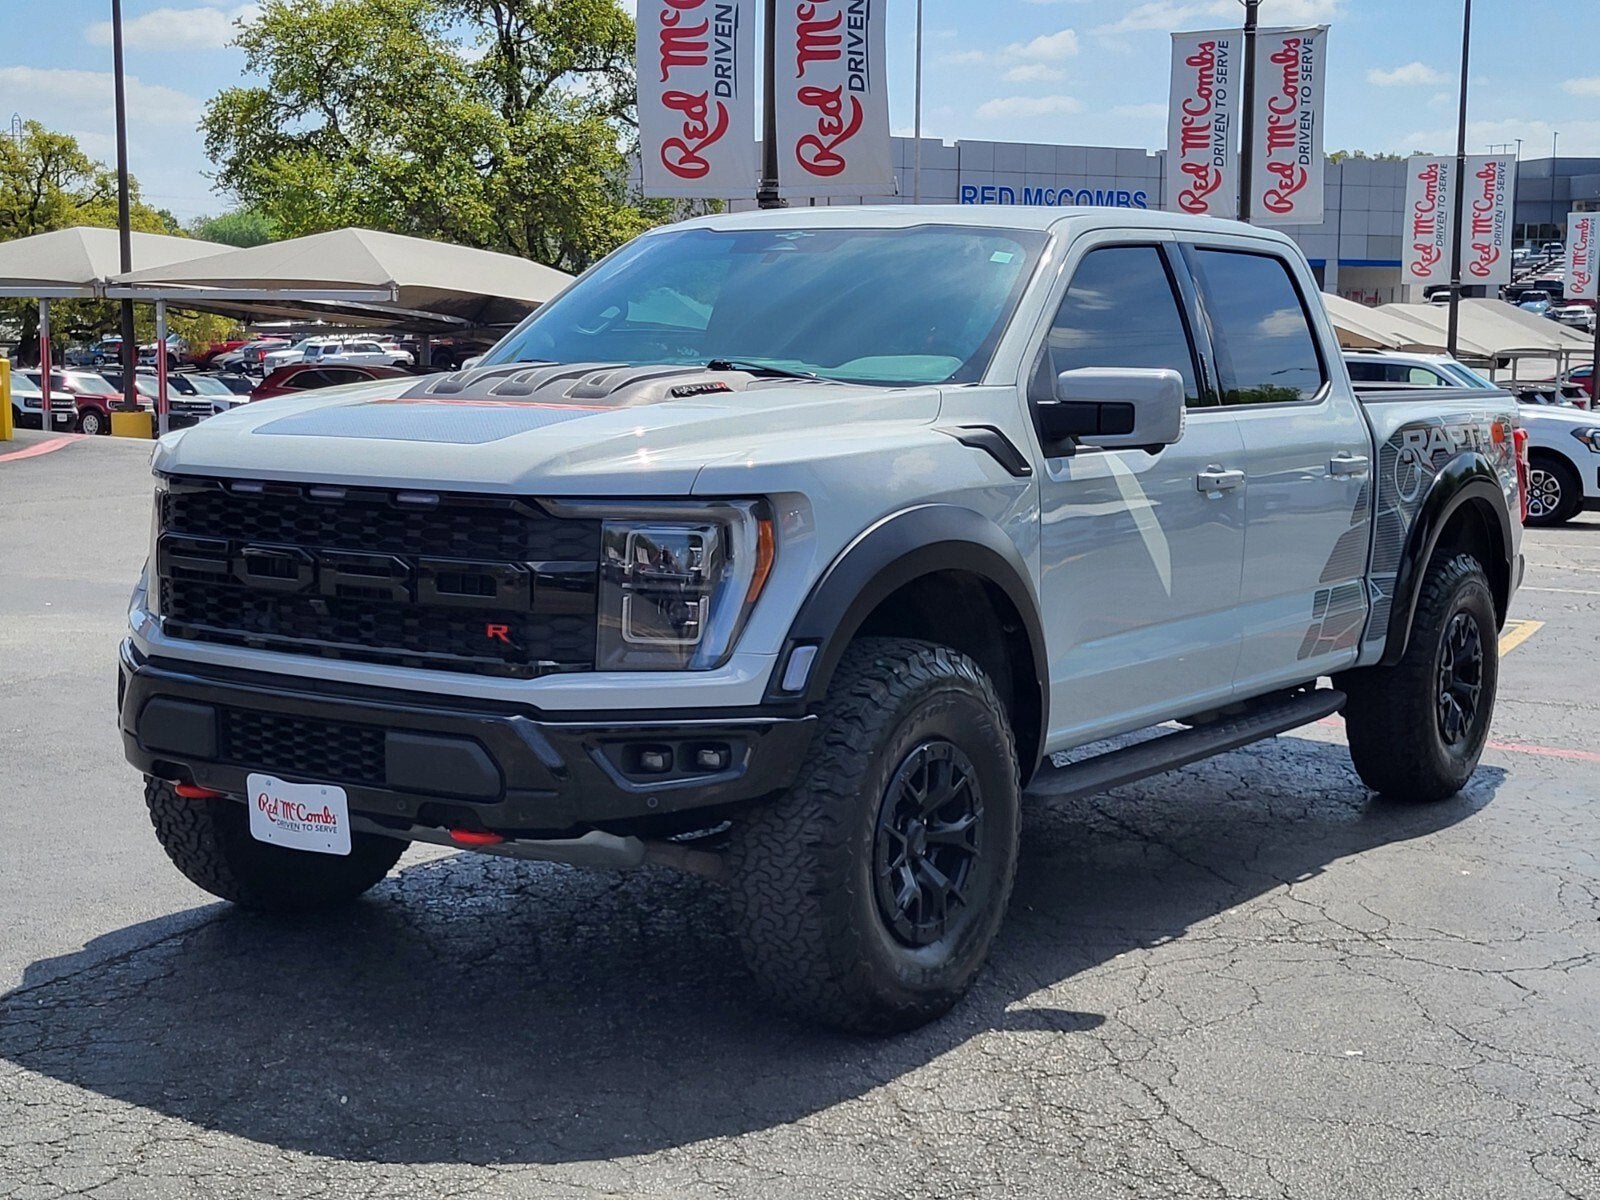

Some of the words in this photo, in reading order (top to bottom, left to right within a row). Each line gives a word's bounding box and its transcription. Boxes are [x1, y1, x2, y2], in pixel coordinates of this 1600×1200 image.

[660, 0, 709, 82] Mc
[715, 4, 732, 98] DRIVEN
[847, 0, 865, 92] DRIVEN
[1217, 41, 1229, 85] SERVE
[1302, 38, 1314, 82] SERVE
[1180, 41, 1216, 158] McCombs
[1216, 88, 1227, 109] TO
[1267, 38, 1301, 157] McCombs
[1301, 86, 1312, 107] TO
[661, 90, 729, 179] Red
[796, 85, 863, 176] Red
[1214, 113, 1226, 167] DRIVEN
[1299, 110, 1311, 165] DRIVEN
[961, 185, 1015, 205] RED
[1178, 162, 1222, 214] Red
[1263, 161, 1307, 213] Red
[1439, 163, 1448, 192] SERVE
[1497, 161, 1507, 190] SERVE
[1413, 163, 1439, 240] McCombs
[1437, 195, 1446, 210] TO
[1471, 162, 1497, 240] McCombs
[1496, 193, 1505, 208] TO
[1435, 210, 1445, 247] DRIVEN
[1494, 210, 1504, 246] DRIVEN
[1572, 217, 1589, 267] McCombs
[1411, 243, 1441, 277] Red
[1469, 243, 1500, 277] Red
[1570, 271, 1591, 294] Red
[487, 623, 510, 642] R
[258, 793, 279, 822] Red
[280, 800, 337, 825] McCombs
[277, 819, 300, 831] DRIVEN
[302, 823, 313, 831] TO
[315, 825, 337, 833] SERVE
